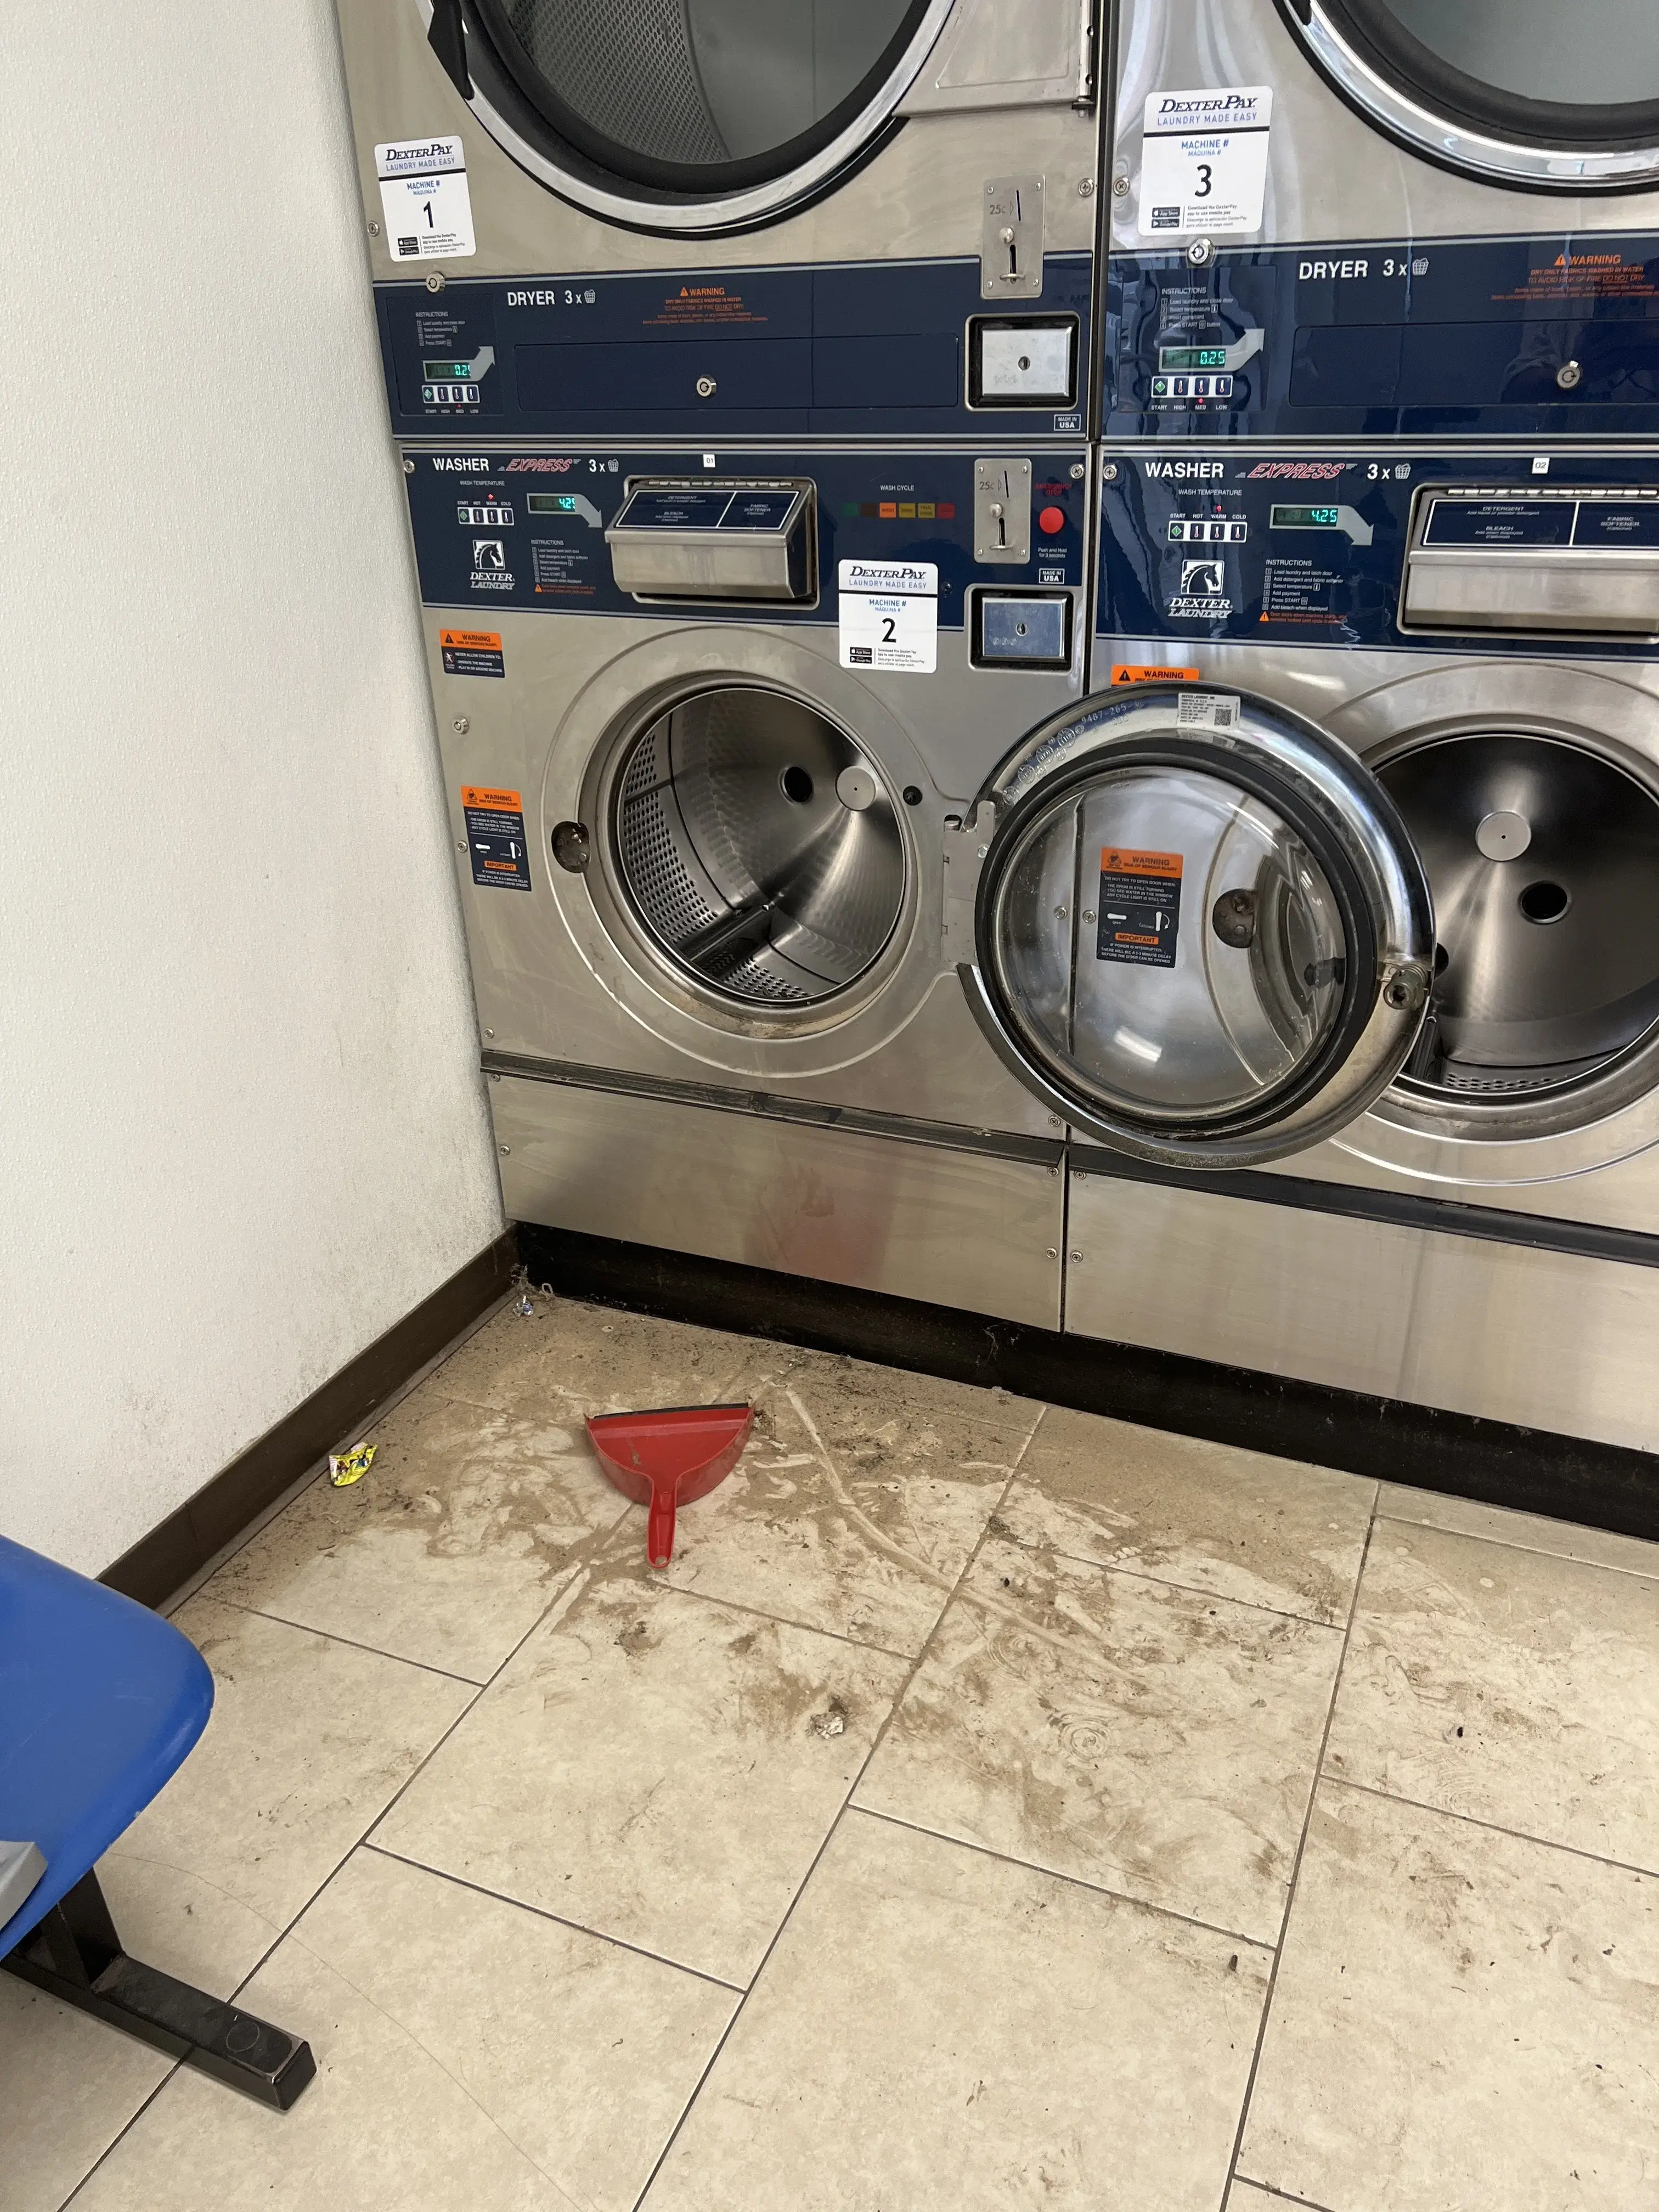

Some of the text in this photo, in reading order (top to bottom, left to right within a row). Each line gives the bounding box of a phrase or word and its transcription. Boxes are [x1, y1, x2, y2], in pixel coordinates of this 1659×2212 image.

[1158, 112, 1257, 126] LAUNDRY MADE EASY
[1181, 138, 1229, 149] MACHINE #
[386, 157, 455, 172] LAUNDRY MADE EASY
[407, 180, 435, 190] MACHINE
[1194, 164, 1212, 197] 3
[423, 201, 434, 228] 1
[1568, 255, 1621, 265] WARNING
[1299, 258, 1407, 280] DRYER 3 x
[689, 287, 725, 296] WARNING
[507, 290, 582, 306] DRYER 3 x
[432, 458, 606, 472] WASHER EXPRESS 3 x
[1145, 462, 1390, 479] WASHER EXPRESS 3 x
[470, 572, 513, 582] DEXTER
[470, 580, 515, 590] LAUNDRY
[849, 579, 927, 590] LAUNDRY MADE EASY
[869, 599, 900, 607] MACHINE
[1169, 597, 1231, 609] DEXTER
[1169, 608, 1233, 619] LAUNDRY
[882, 618, 896, 643] 2
[461, 634, 490, 642] WARNING
[1144, 670, 1184, 679] WARNING
[483, 792, 512, 802] WARNING
[1132, 856, 1170, 866] WARNING
[1118, 934, 1156, 943] IMPORTANT
